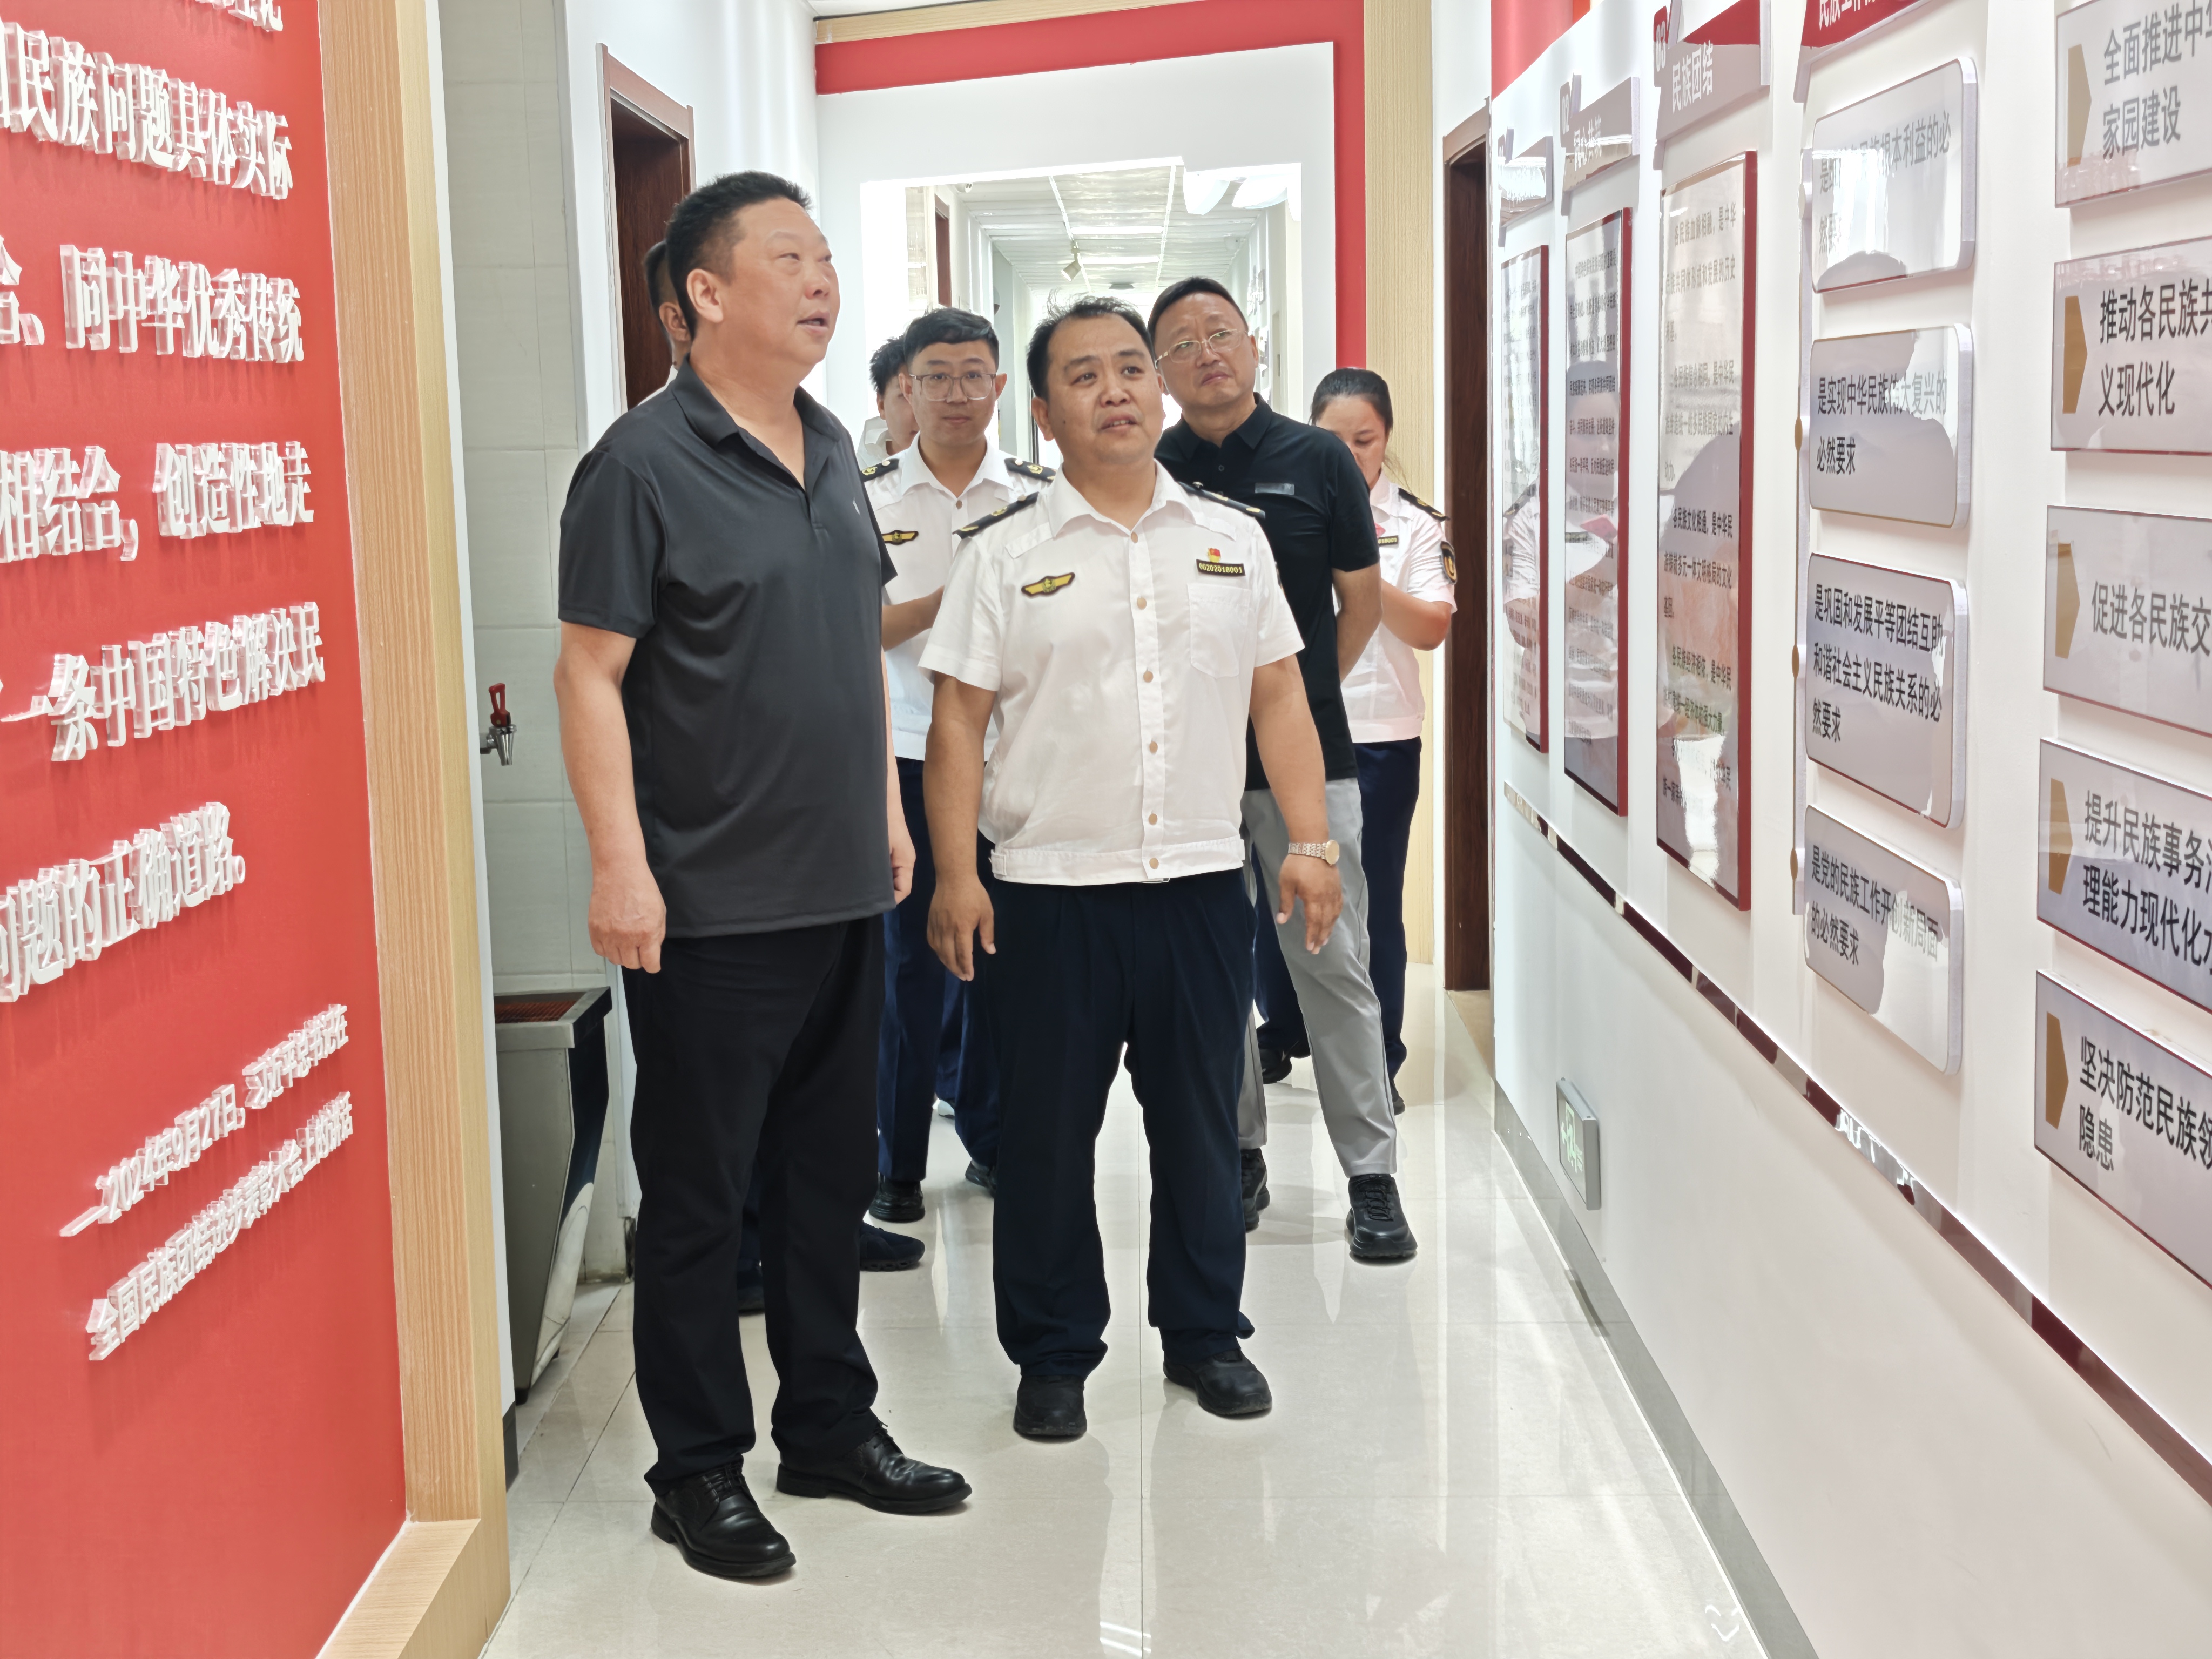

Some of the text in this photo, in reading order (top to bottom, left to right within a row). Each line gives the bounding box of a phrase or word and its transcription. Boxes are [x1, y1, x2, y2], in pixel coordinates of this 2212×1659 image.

[1656, 21, 1666, 72] 03
[1673, 39, 1714, 114] 民族团结
[0, 15, 293, 200] 民族问题具体实际
[2103, 85, 2181, 159] 家园建设
[1820, 110, 1951, 194] 是根本利益的必
[2100, 278, 2212, 344] 推动各民族共
[2098, 361, 2175, 417] 义现代化
[1817, 436, 1856, 475] 必然要求
[1815, 584, 1943, 655] 是巩固和发展平等团结互助
[2092, 581, 2211, 657] 促进各民族交
[1813, 642, 1943, 723] 和谐社会主义民族关系的必
[1812, 697, 1841, 743] 然要求
[1811, 900, 1859, 966] 的必然要求
[1812, 845, 1939, 962] 是党的民族工作开创新局面
[2079, 1036, 2212, 1170] 坚决防范民族领
[2079, 1104, 2114, 1171] 隐患
[86, 1091, 353, 1361] 全国民族团结进步表彰大会上的讲话
